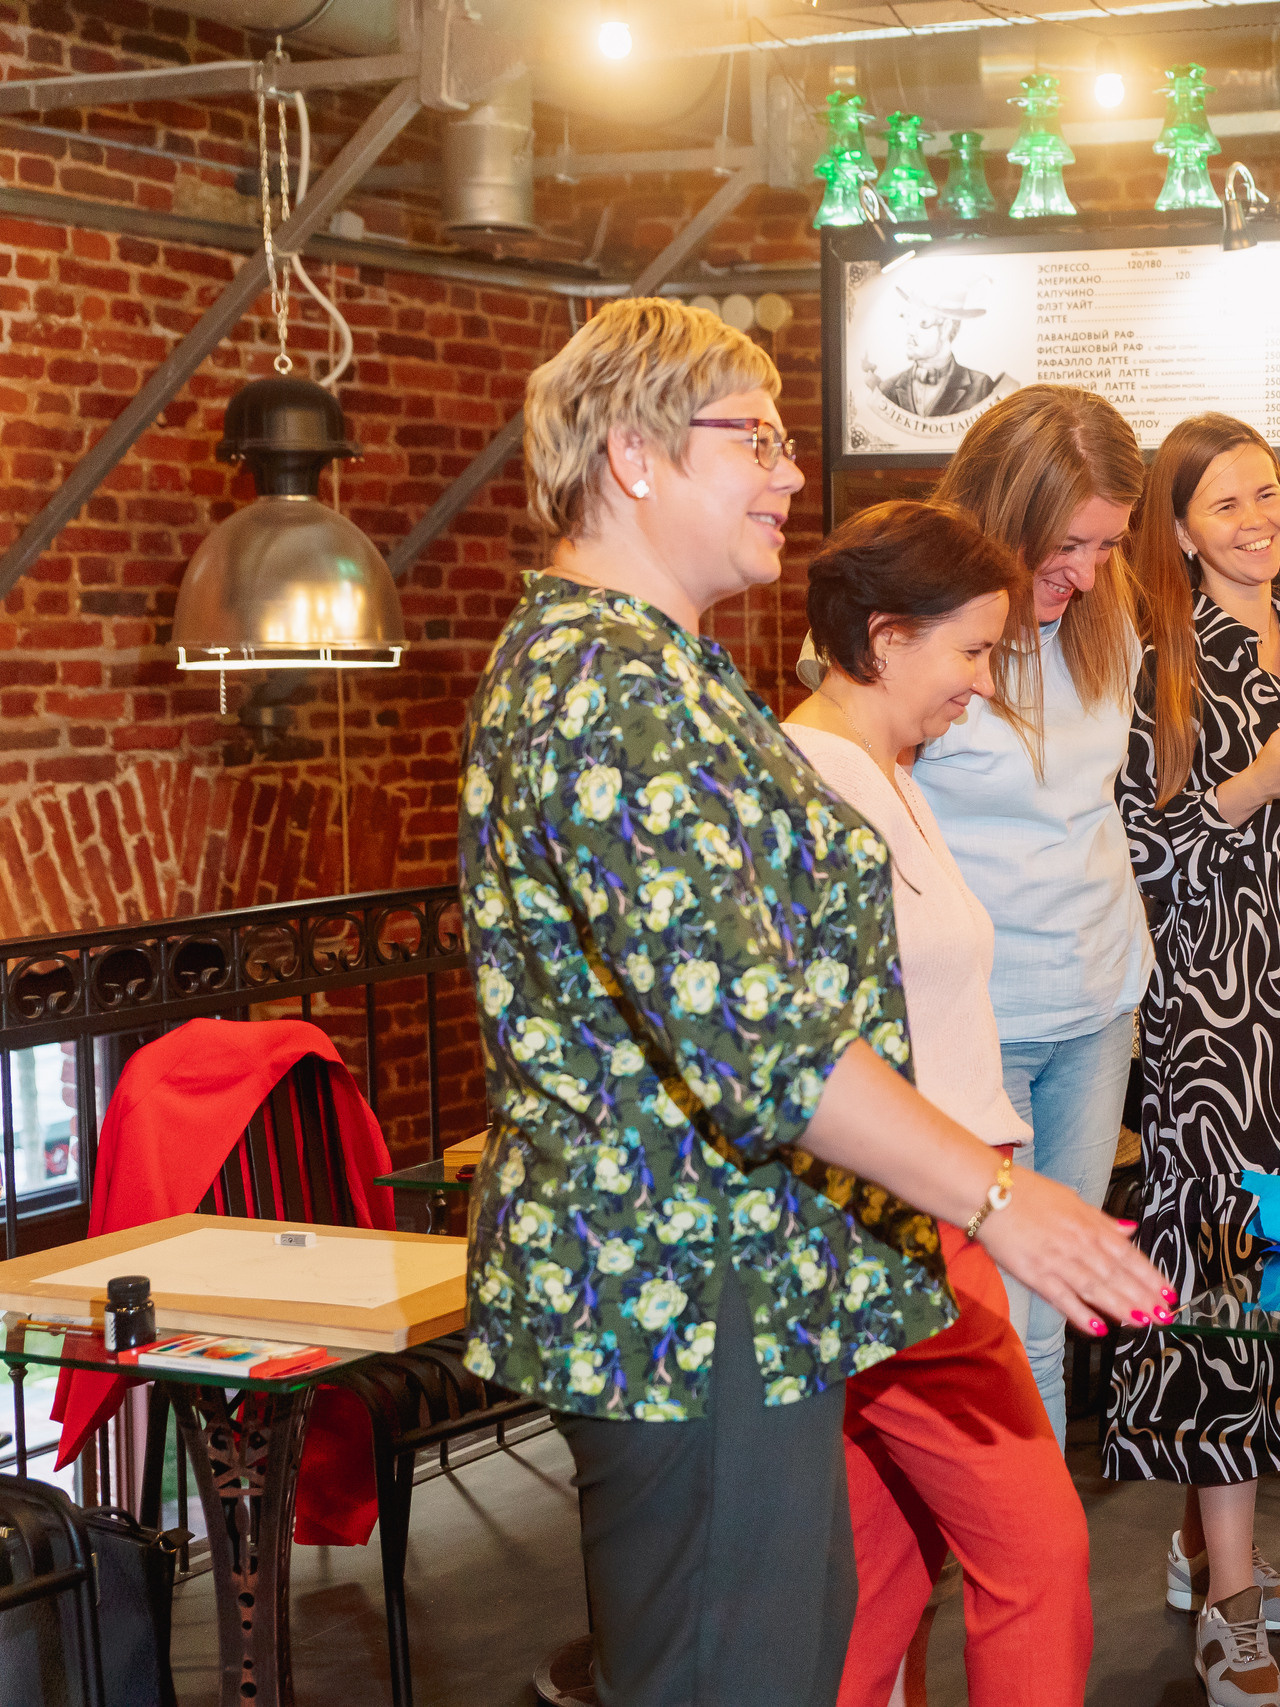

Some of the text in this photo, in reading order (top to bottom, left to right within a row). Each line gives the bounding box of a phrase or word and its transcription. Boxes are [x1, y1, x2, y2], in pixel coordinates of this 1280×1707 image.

[1038, 260, 1162, 273] ЭСПРЕССО 120/180
[1037, 271, 1190, 285] АМЕРИКАНО 120
[1037, 288, 1094, 298] КАПУЧИНО
[1037, 300, 1093, 311] ФЛЭТ УАЙТ
[1037, 315, 1067, 324] ЛАТТЕ
[1037, 330, 1108, 342] ЛАВАНДОВЫЙ
[1115, 331, 1134, 340] РАФ
[1037, 343, 1118, 355] ФИСТАШКОВЫЙ
[1123, 343, 1143, 351] РАФ
[1037, 358, 1092, 367] РАФАЭЛЛО
[1097, 356, 1129, 365] ЛАТТЕ
[1265, 351, 1280, 360] 250
[1037, 368, 1111, 380] БЕЛЬГИЙСКИЙ
[1119, 368, 1149, 377] ЛАТТЕ
[1265, 365, 1280, 373] 250
[1105, 381, 1136, 391] ЛАТТЕ
[1265, 378, 1280, 386] 250
[1265, 391, 1280, 399] 250
[879, 395, 1001, 434] ЭЛЕКТРОСТАН
